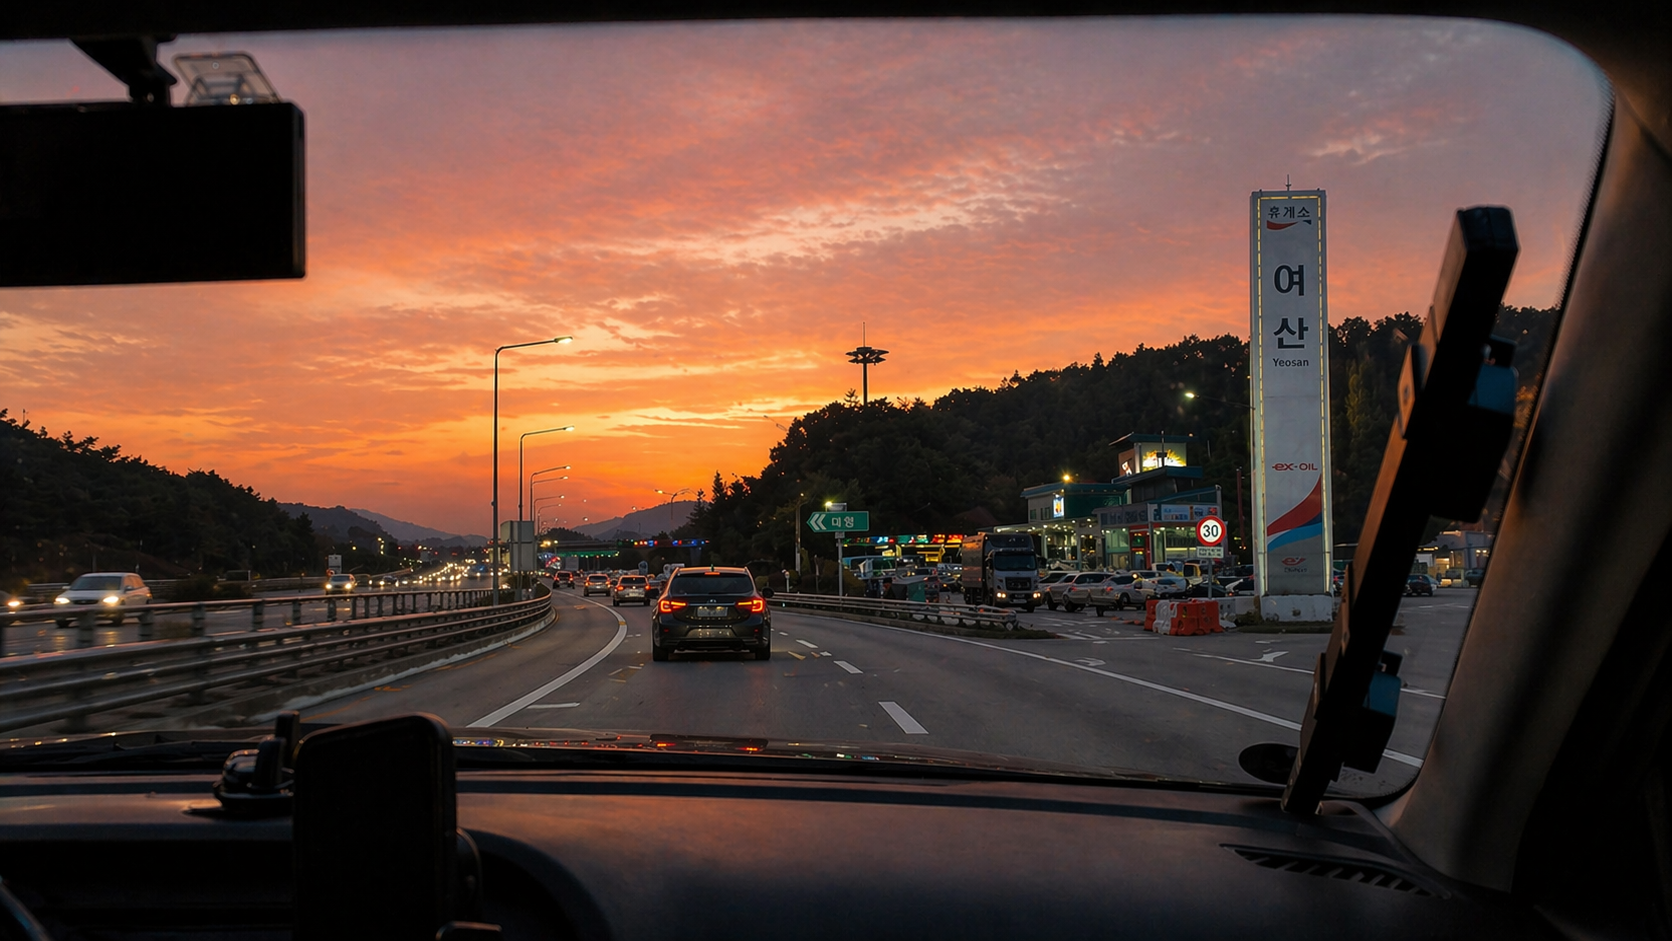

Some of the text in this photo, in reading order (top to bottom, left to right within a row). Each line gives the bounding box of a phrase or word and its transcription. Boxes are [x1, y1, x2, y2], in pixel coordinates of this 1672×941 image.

[1268, 206, 1311, 219] 휴게소
[1272, 358, 1310, 367] Yeosan
[1203, 524, 1219, 538] 30
